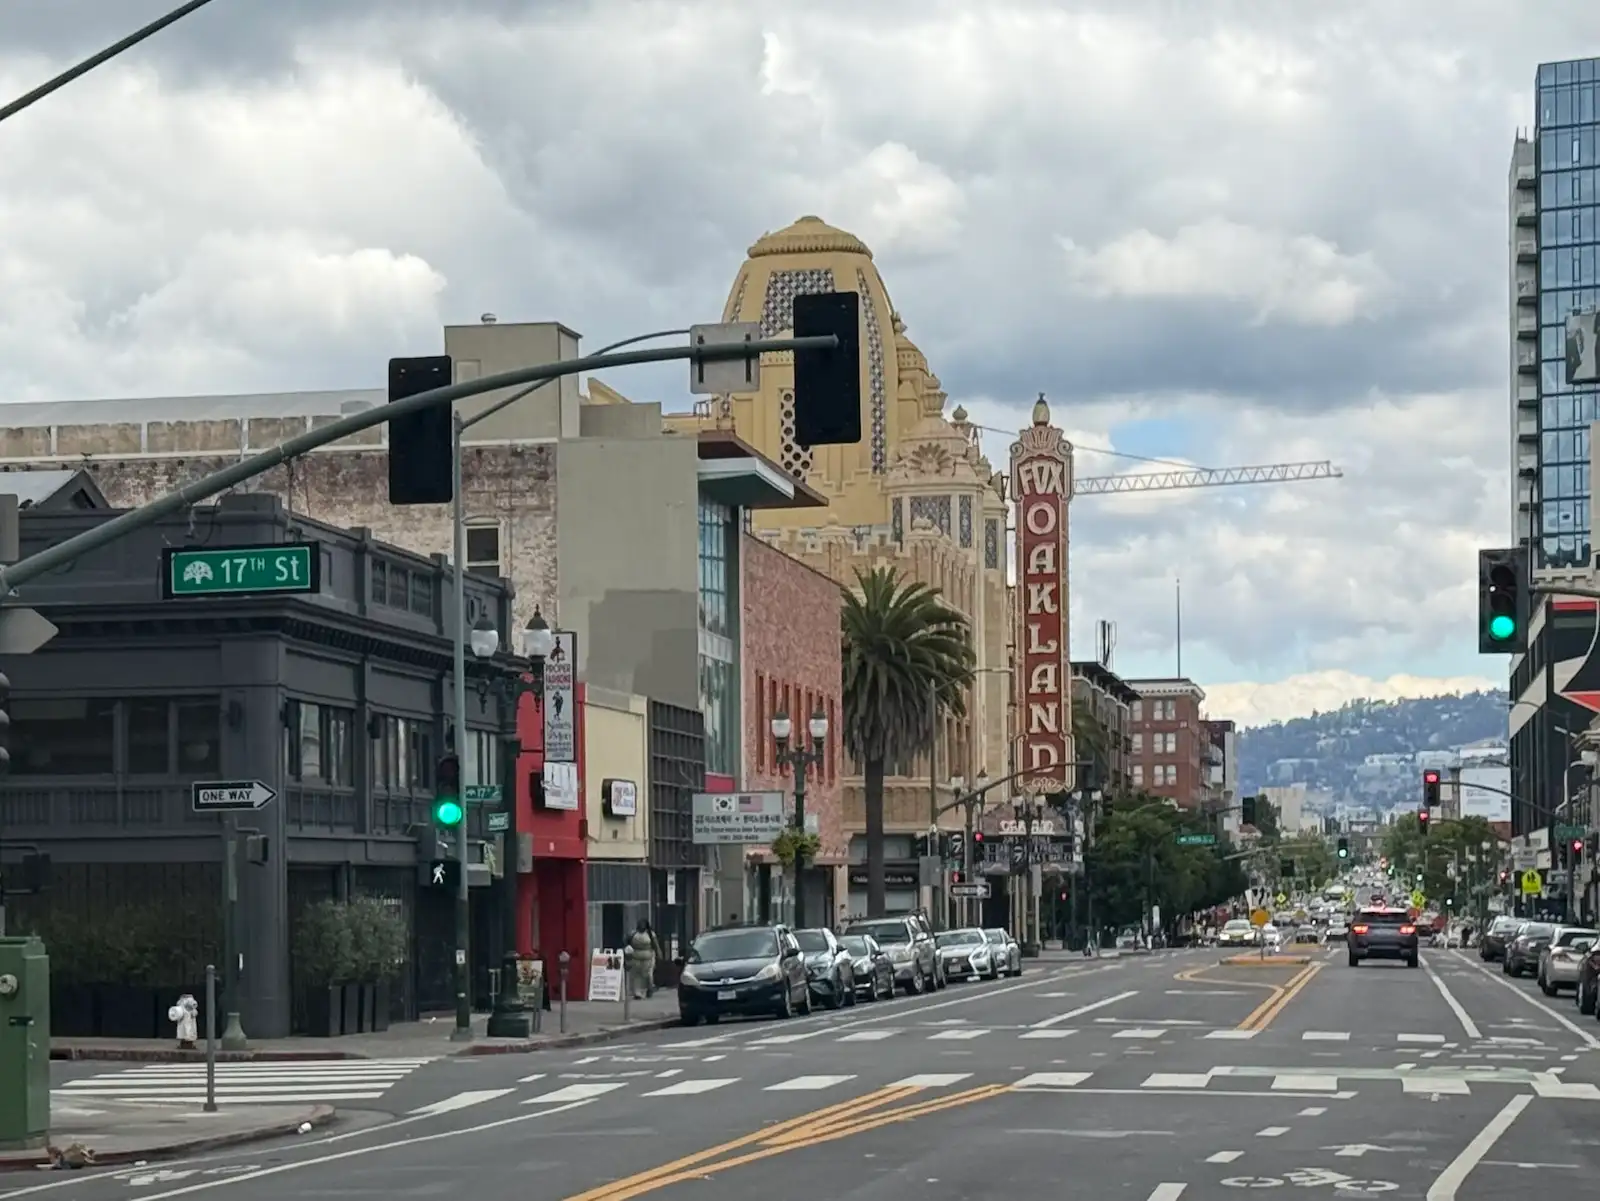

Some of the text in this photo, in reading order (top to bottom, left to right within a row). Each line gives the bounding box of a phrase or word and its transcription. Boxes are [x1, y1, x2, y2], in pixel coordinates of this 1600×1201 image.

[1018, 459, 1064, 495] FOX
[220, 556, 300, 584] 17TH St
[1026, 501, 1059, 773] OAKLAND
[202, 790, 252, 802] ONE WAY
